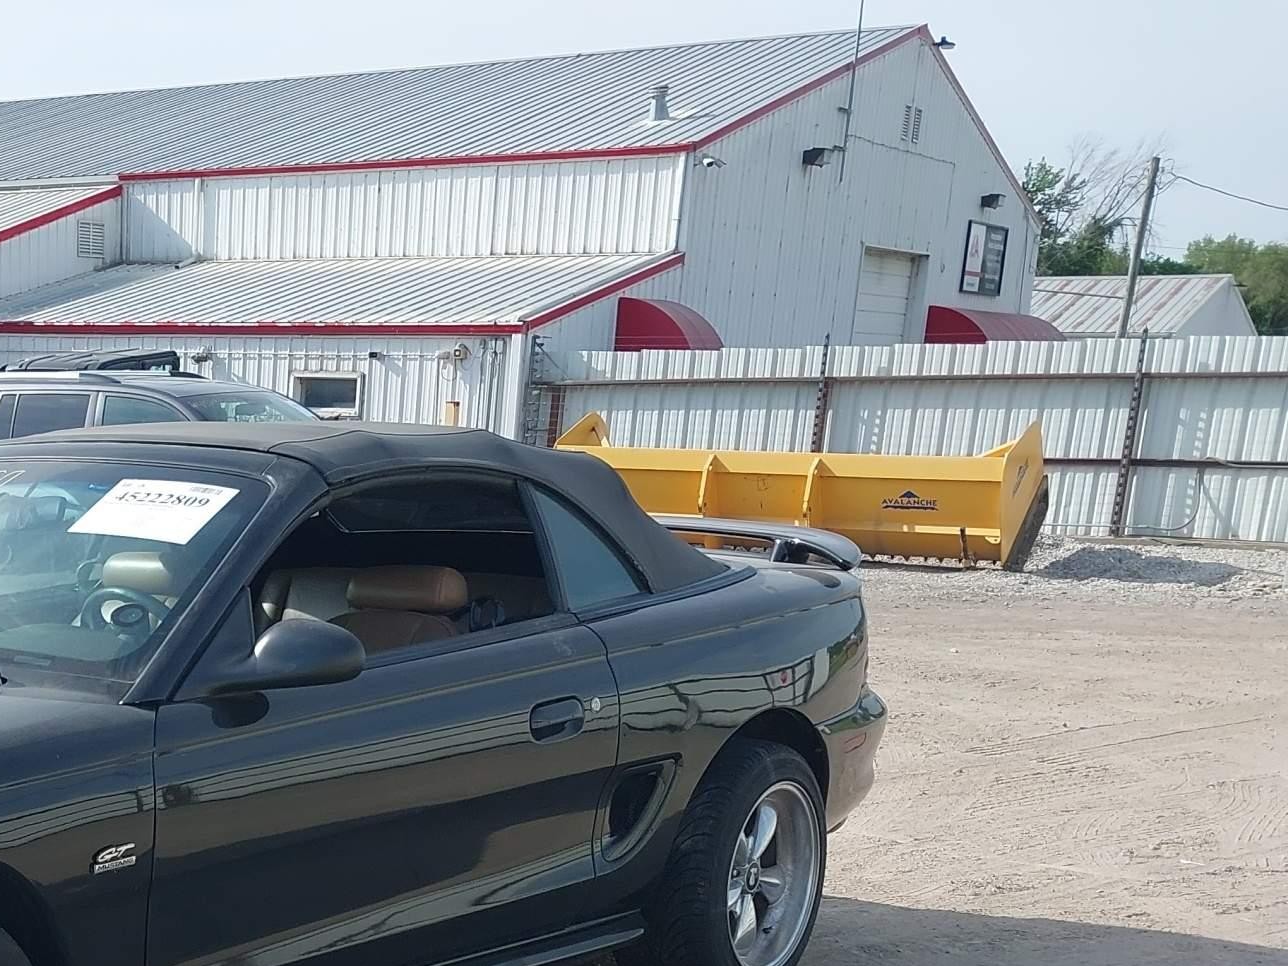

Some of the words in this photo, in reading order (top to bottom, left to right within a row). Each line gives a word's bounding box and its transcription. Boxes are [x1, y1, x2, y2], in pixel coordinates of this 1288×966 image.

[115, 491, 211, 508] 45222809
[881, 498, 937, 507] AVALANCHE
[97, 843, 135, 862] GT
